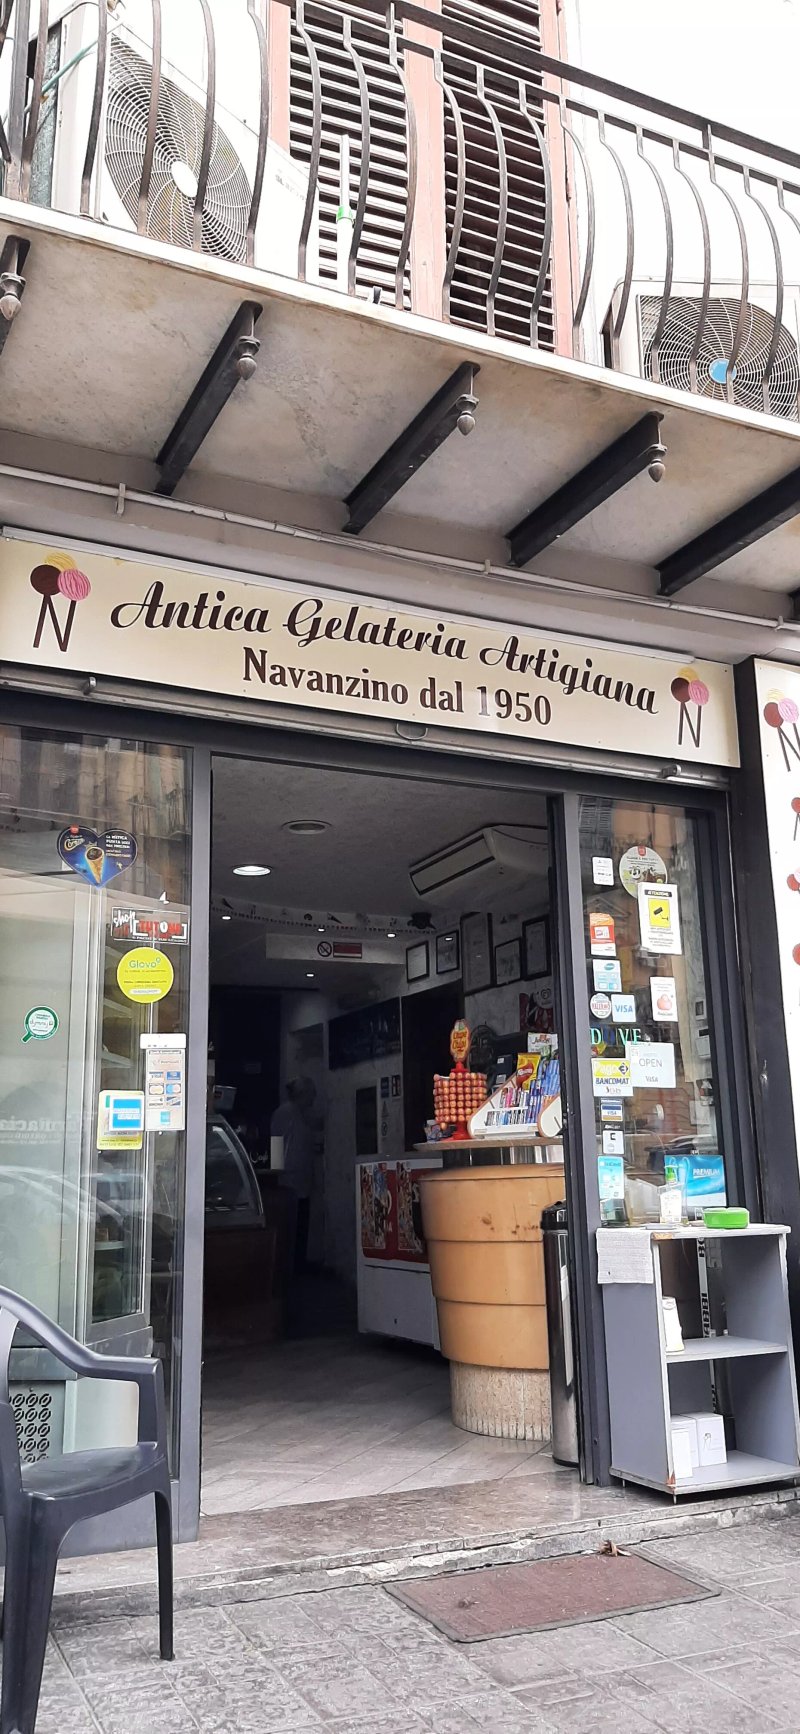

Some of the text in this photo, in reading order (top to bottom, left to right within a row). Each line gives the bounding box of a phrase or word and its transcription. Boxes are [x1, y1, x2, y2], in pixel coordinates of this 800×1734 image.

[111, 580, 659, 715] Antica Gelateria Artigiana
[243, 646, 551, 726] Navanzino dal 1950
[129, 959, 158, 969] Glovo
[615, 1005, 634, 1013] VISA
[638, 1058, 663, 1068] OPEN
[595, 1077, 630, 1085] BANCOMAT
[645, 1075, 659, 1083] VISA
